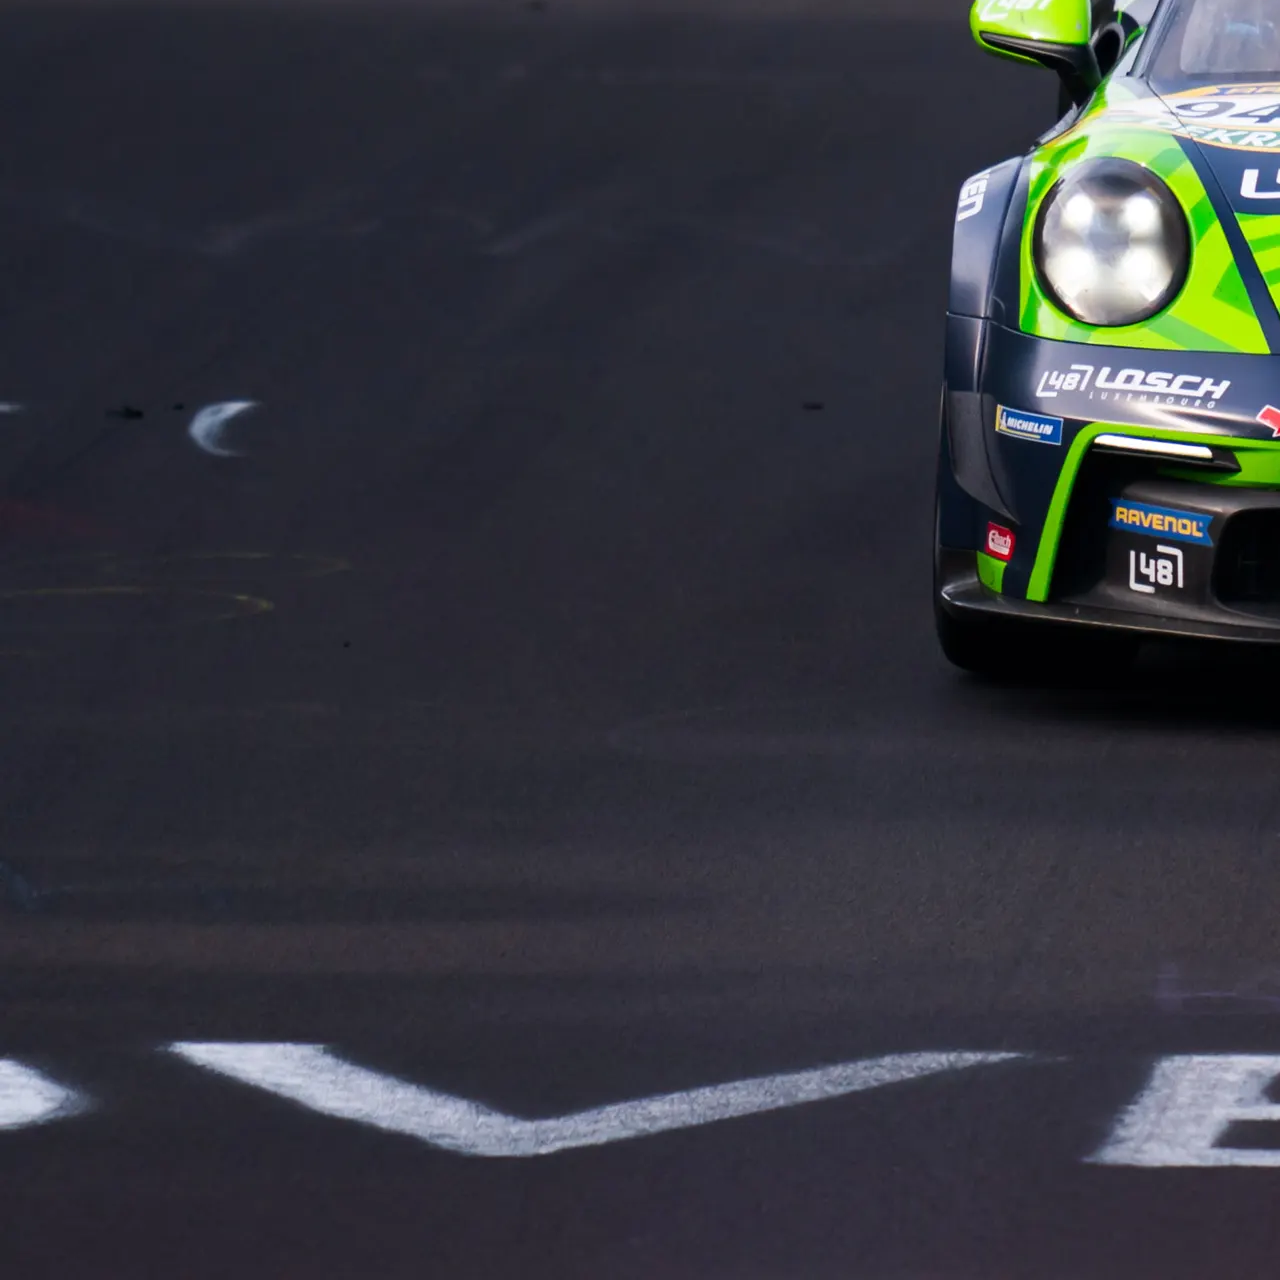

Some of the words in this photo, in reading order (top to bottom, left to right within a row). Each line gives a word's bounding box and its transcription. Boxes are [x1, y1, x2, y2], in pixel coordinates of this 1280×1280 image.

[1095, 366, 1232, 400] LOSCH
[1088, 390, 1217, 410] LUXEMBOURG
[1007, 418, 1054, 436] MICHELIN
[1115, 507, 1204, 538] RAVENOL
